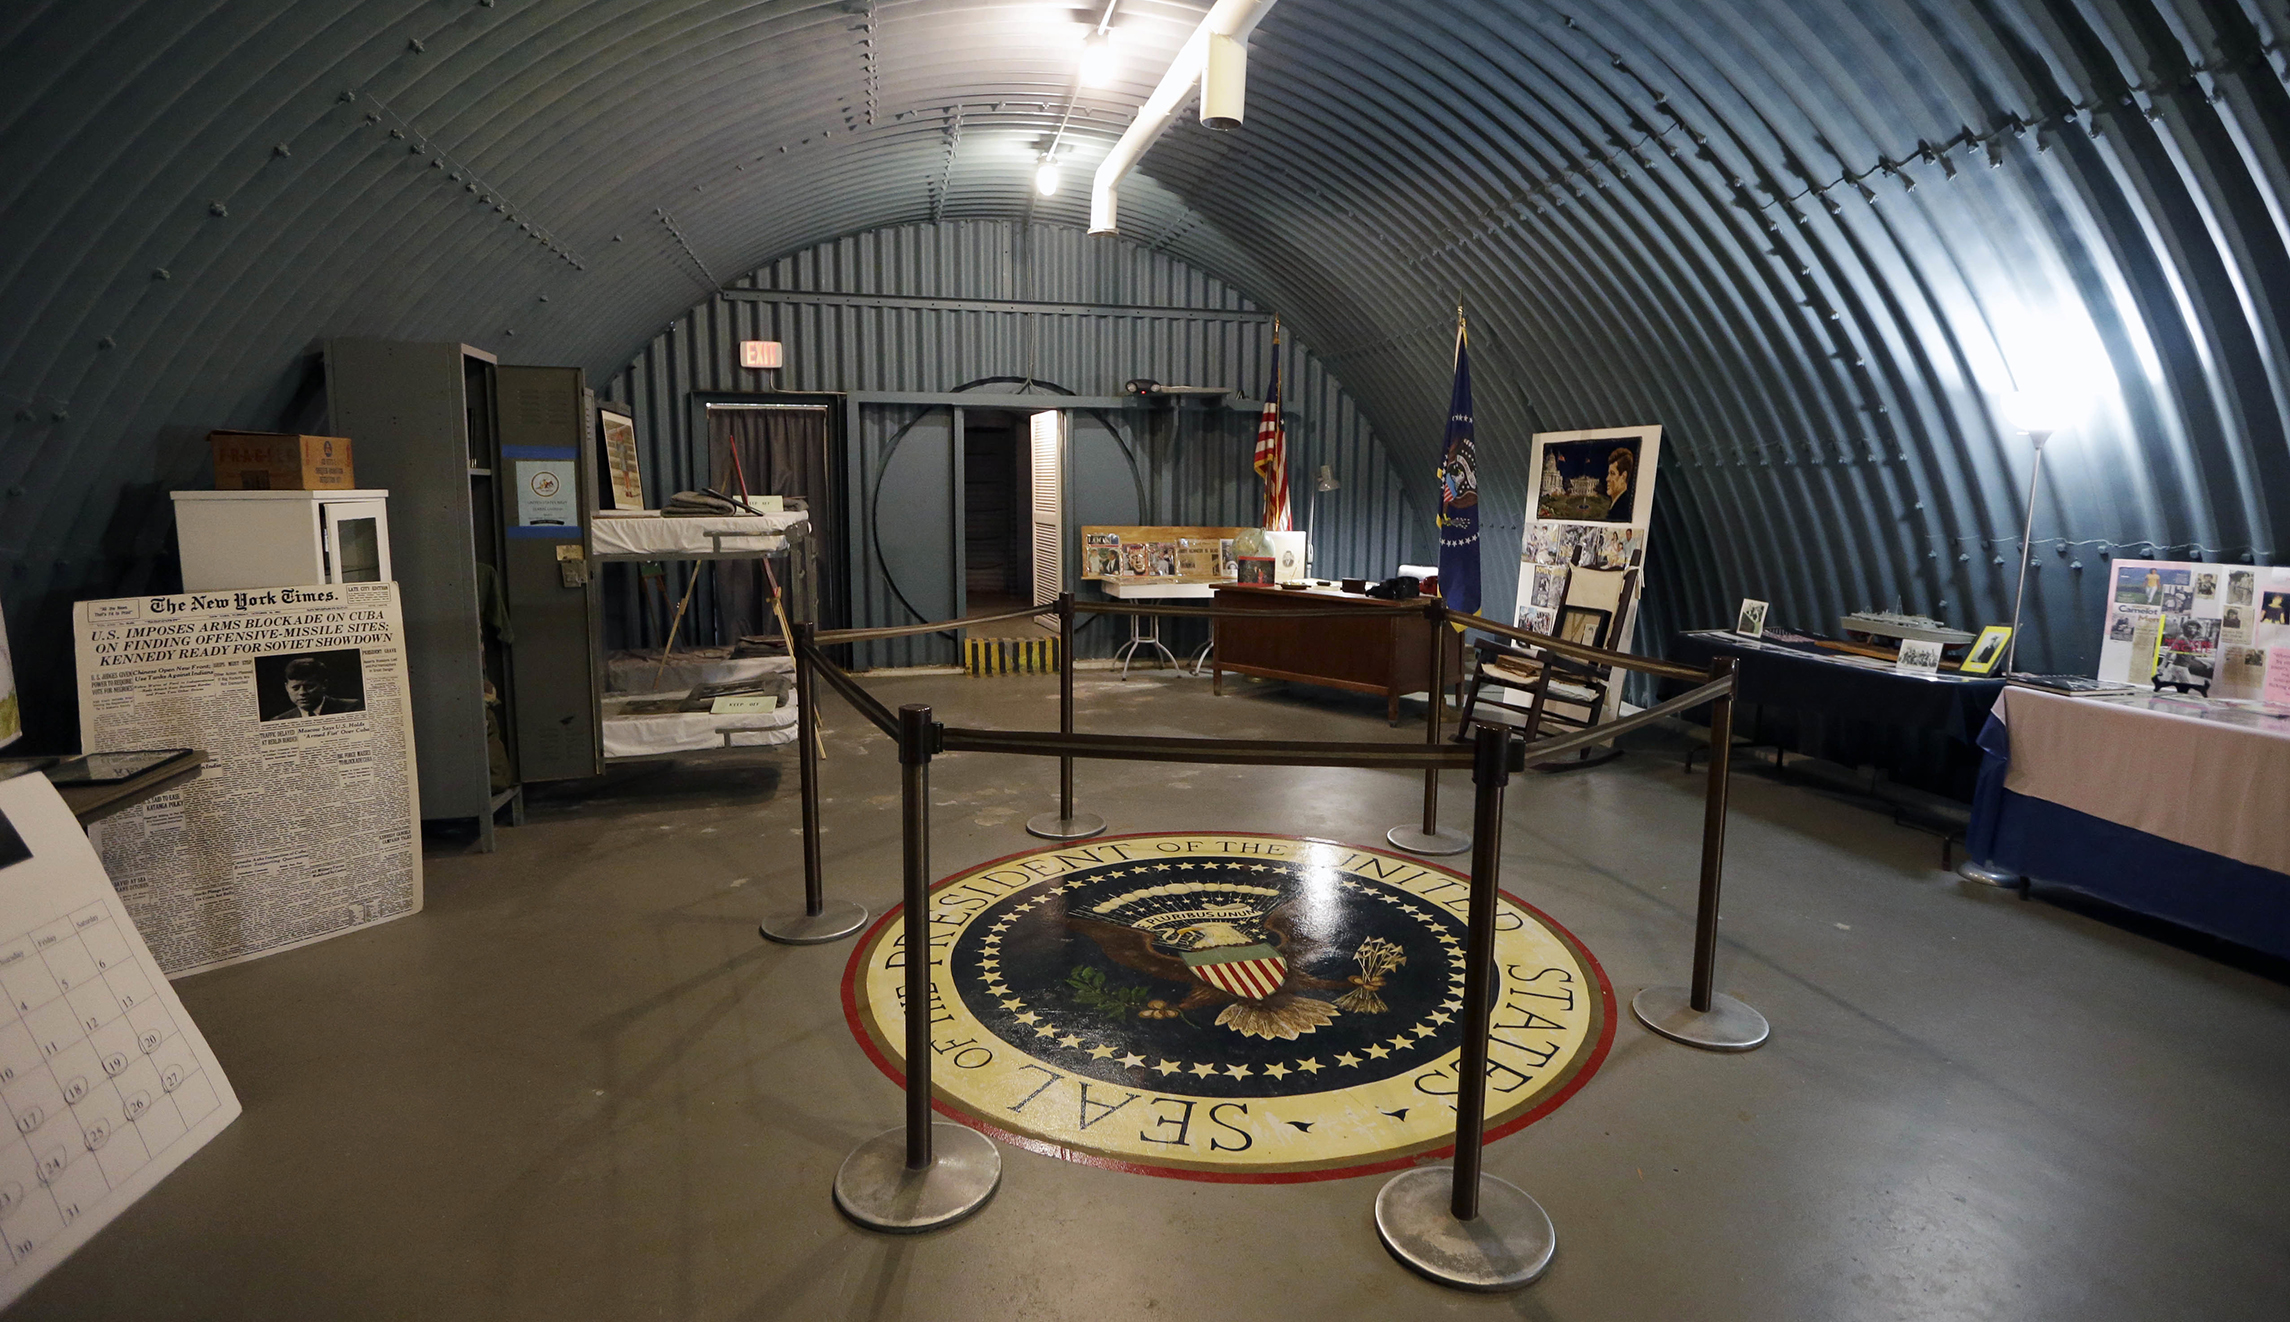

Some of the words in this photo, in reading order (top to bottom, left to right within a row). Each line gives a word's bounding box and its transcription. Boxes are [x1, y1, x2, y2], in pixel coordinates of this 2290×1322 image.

[746, 342, 778, 366] EXIT
[150, 597, 187, 615] The
[191, 595, 229, 612] New
[234, 591, 277, 611] York
[281, 588, 339, 604] Times.
[2118, 604, 2158, 615] Camelot
[91, 630, 121, 642] U.S.
[126, 623, 196, 639] IMPOSES
[198, 619, 242, 633] ARMS
[245, 613, 324, 629] BLOCKADE
[326, 612, 346, 623] ON
[349, 610, 385, 622] CUBA
[95, 643, 118, 655] ON
[123, 636, 191, 652] FINDING
[195, 625, 344, 645] OFFENSIVE-MISSILE
[100, 649, 177, 667] KENNEDY
[179, 644, 232, 659] READY
[233, 643, 262, 655] FOR
[263, 638, 315, 653] SOVIET
[315, 632, 394, 647] SHOWDOWN
[132, 668, 158, 676] Chinese
[158, 666, 176, 675] Open
[147, 673, 168, 682] Tanks
[167, 670, 191, 680] Against
[191, 669, 214, 678] Indians
[322, 724, 335, 732] Says
[340, 728, 354, 736] Over
[1156, 840, 1214, 855] OF
[1220, 840, 1290, 855] THE
[1147, 911, 1216, 926] PLURIBUS
[1217, 909, 1260, 919] UNUM
[37, 934, 57, 947] Friday
[76, 914, 99, 929] Saturday
[99, 959, 107, 969] 6
[61, 979, 70, 990] 5
[20, 1002, 28, 1012] 4
[121, 995, 135, 1009] 13
[85, 1016, 99, 1031] 12
[44, 1041, 59, 1056] 11
[143, 1034, 158, 1049] 20
[931, 1037, 993, 1070] OF
[108, 1058, 122, 1072] 19
[166, 1072, 180, 1087] 27
[68, 1085, 83, 1100] 18
[129, 1099, 144, 1114] 26
[1009, 1063, 1254, 1152] SEAL
[22, 1113, 38, 1129] 17
[89, 1128, 105, 1143] 25
[66, 1203, 81, 1218] 31
